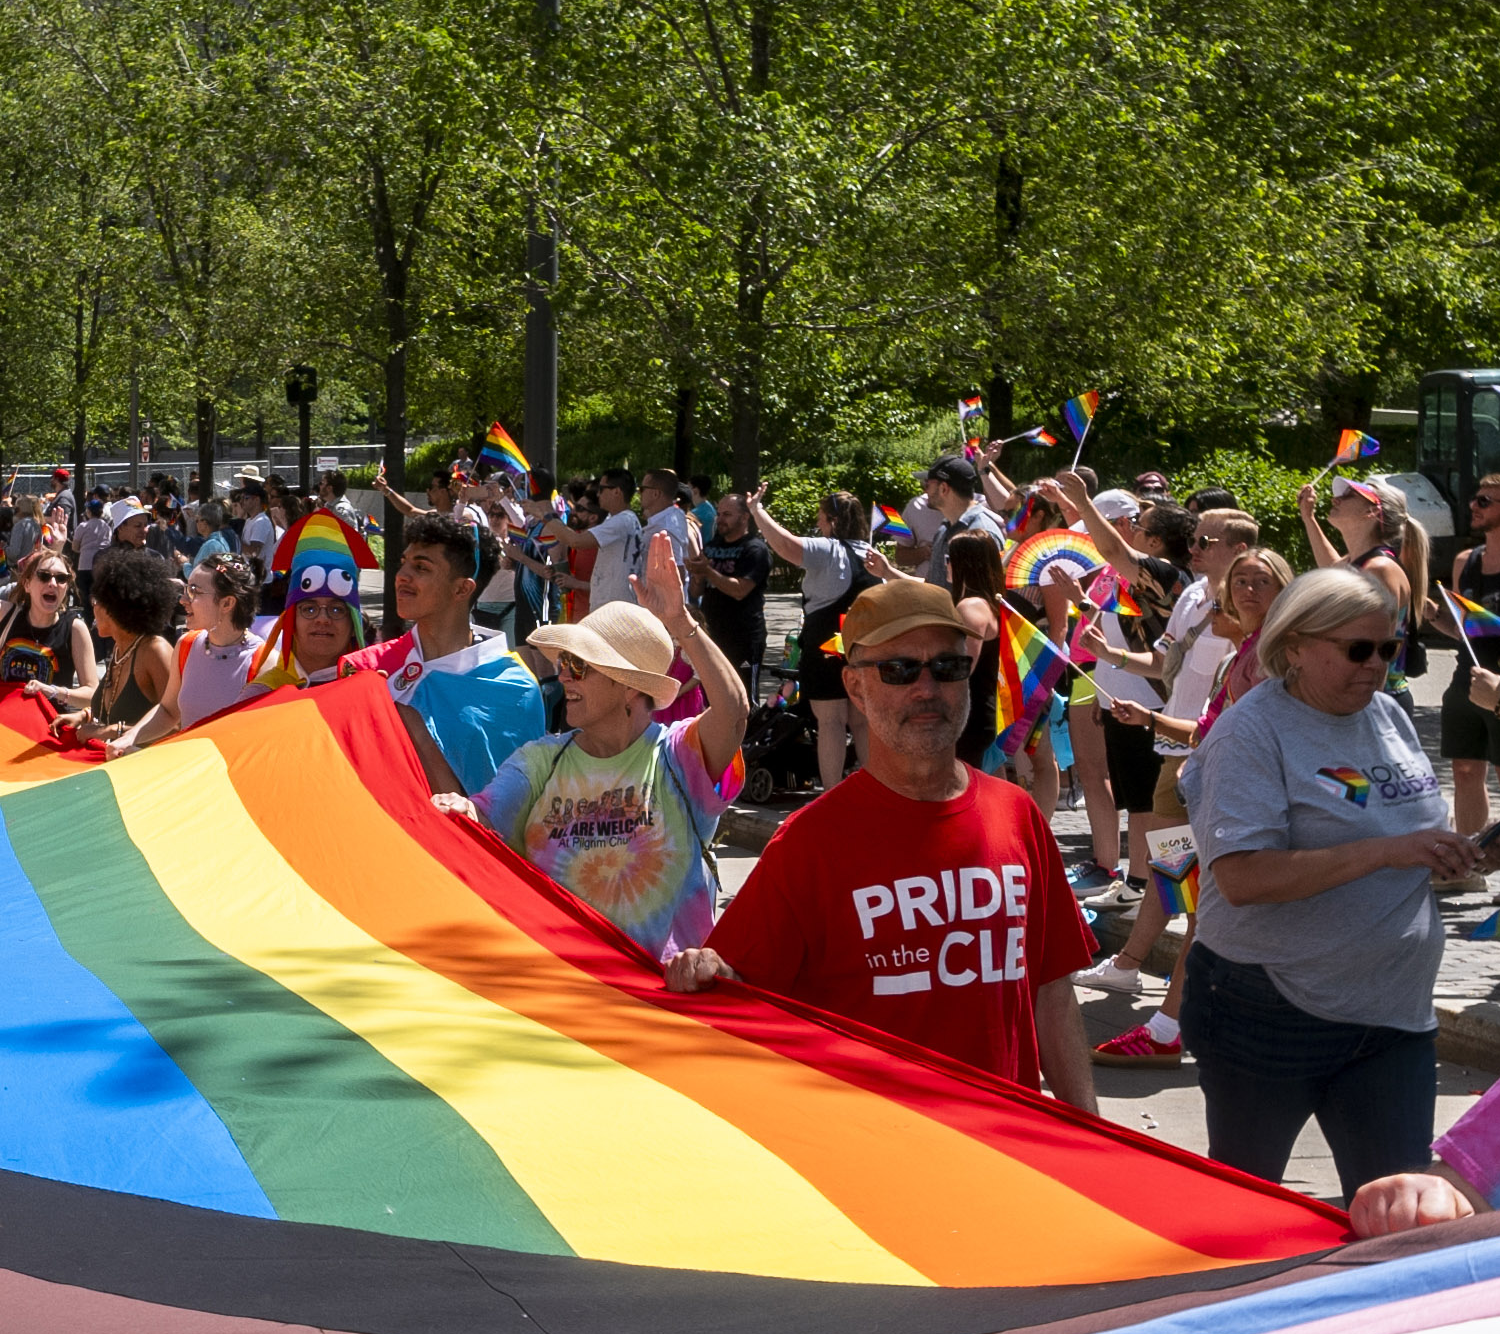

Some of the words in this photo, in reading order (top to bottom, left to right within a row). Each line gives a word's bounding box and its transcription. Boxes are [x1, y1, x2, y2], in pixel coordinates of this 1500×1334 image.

[559, 838, 569, 847] At
[573, 836, 606, 851] Pilgrim
[569, 822, 594, 837] ARE
[597, 811, 654, 836] WELCME
[852, 865, 1027, 939] PRIDE
[865, 952, 887, 969] in
[892, 944, 931, 967] the
[938, 927, 1025, 987] CLE
